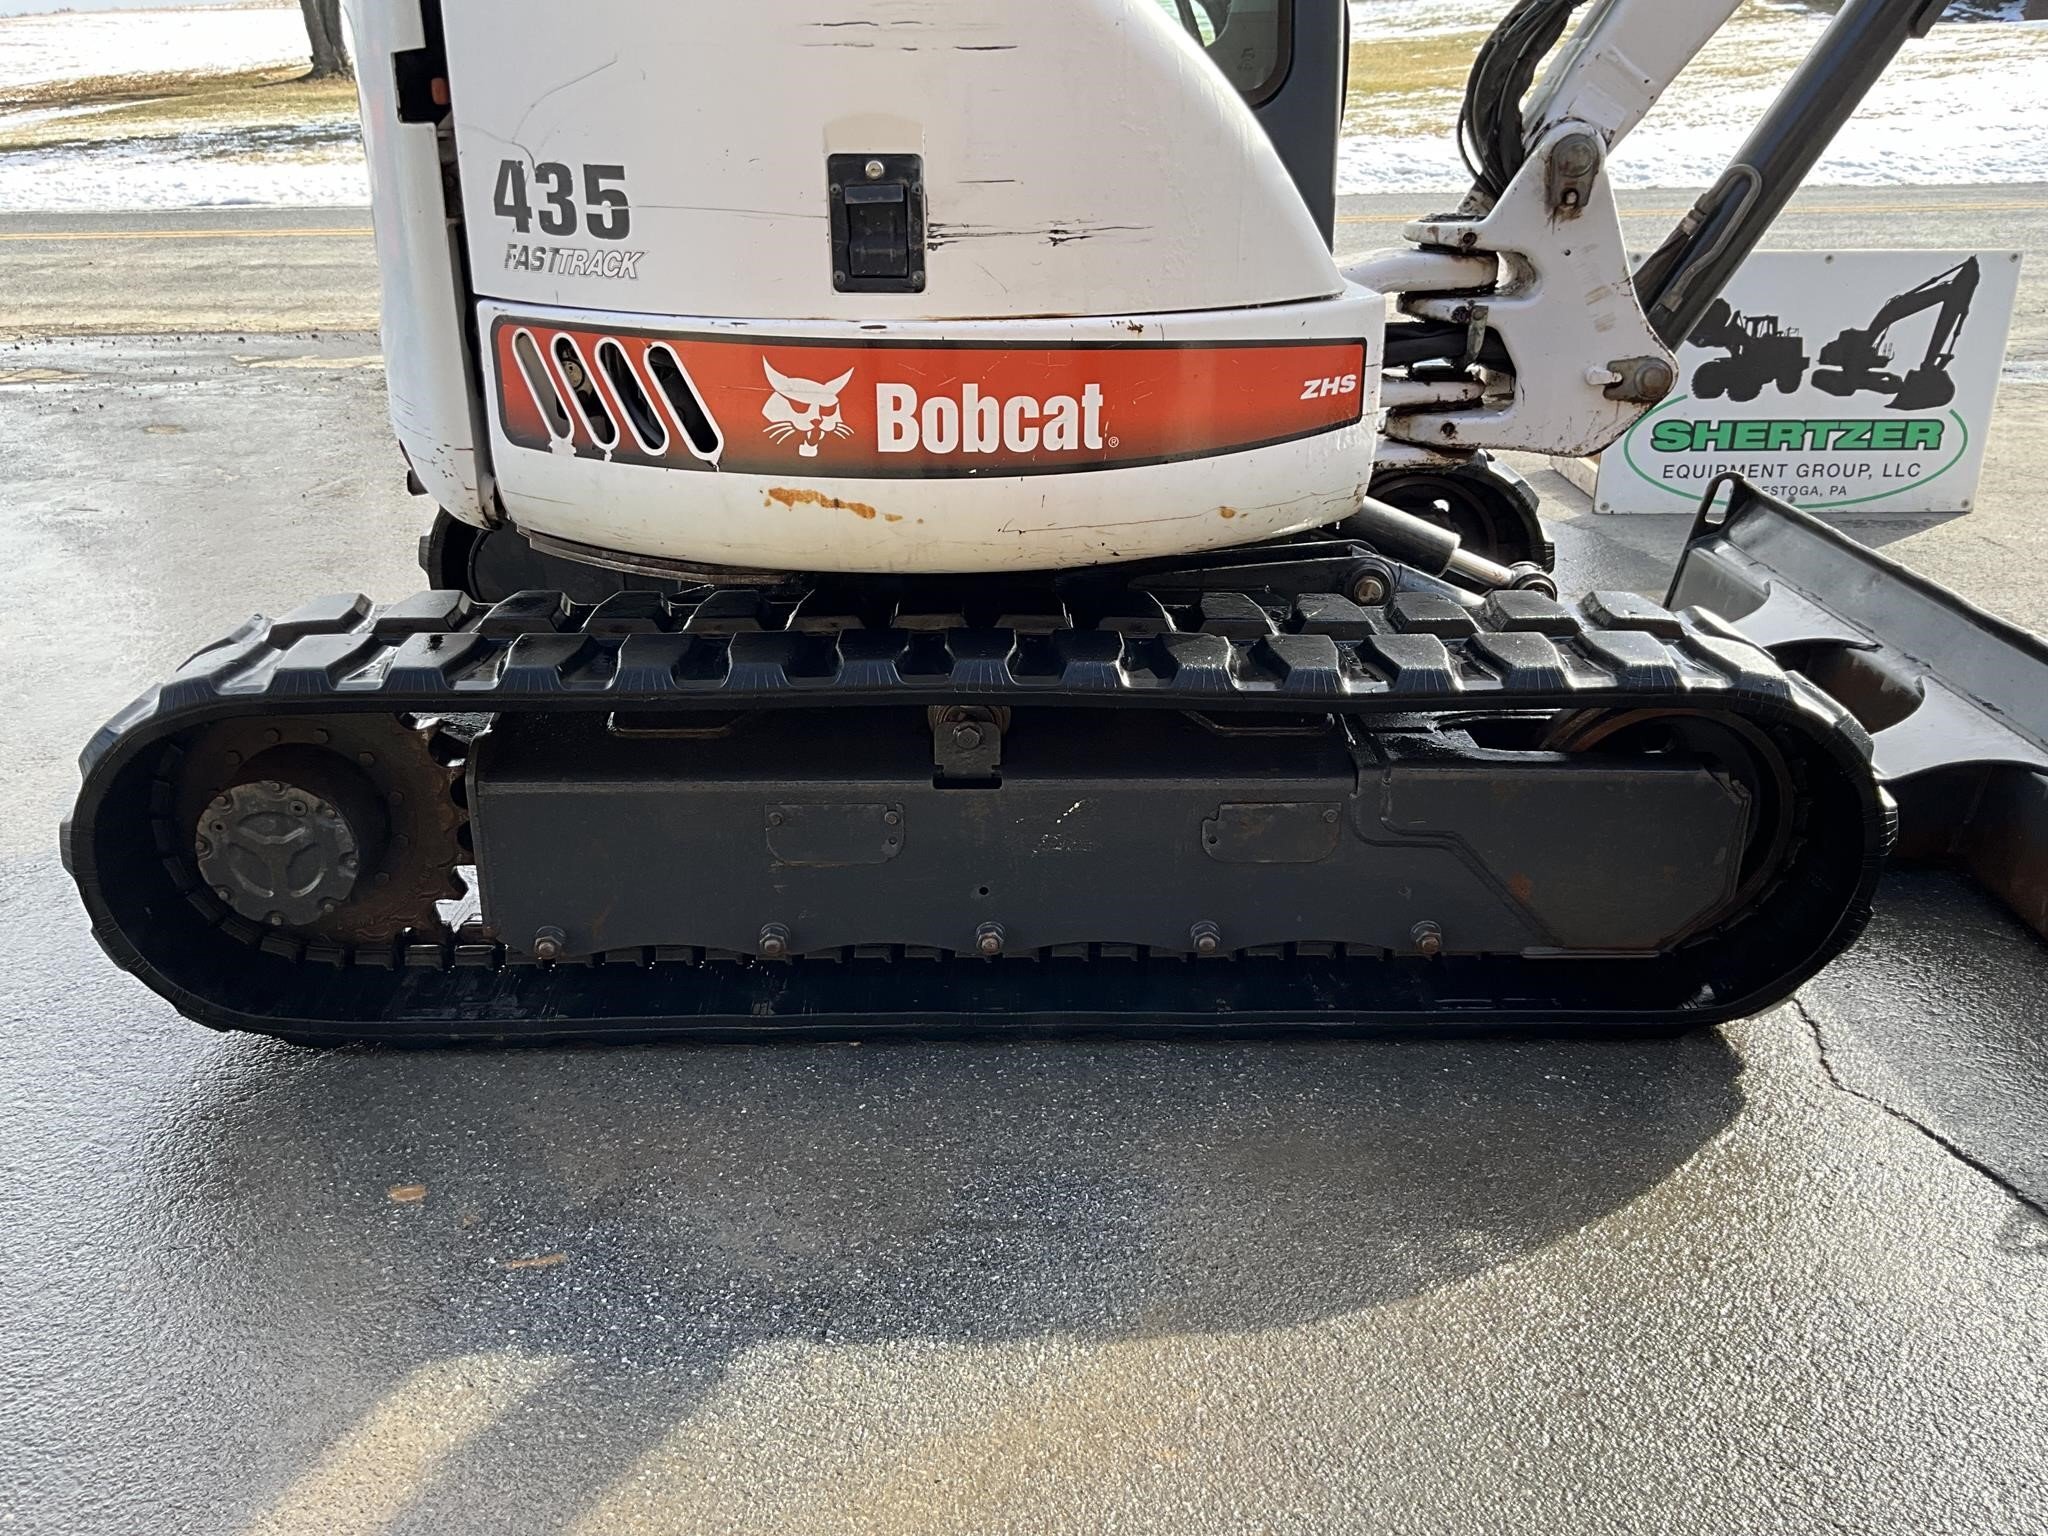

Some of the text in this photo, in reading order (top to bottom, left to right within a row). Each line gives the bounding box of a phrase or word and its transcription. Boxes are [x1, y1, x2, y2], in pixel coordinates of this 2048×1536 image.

[493, 159, 631, 240] 435
[1300, 373, 1357, 400] ZHS
[1650, 419, 1945, 452] SHERTZER
[1796, 463, 1873, 480] GROUP,
[1882, 463, 1921, 478] LLC
[1829, 485, 1847, 496] PA
